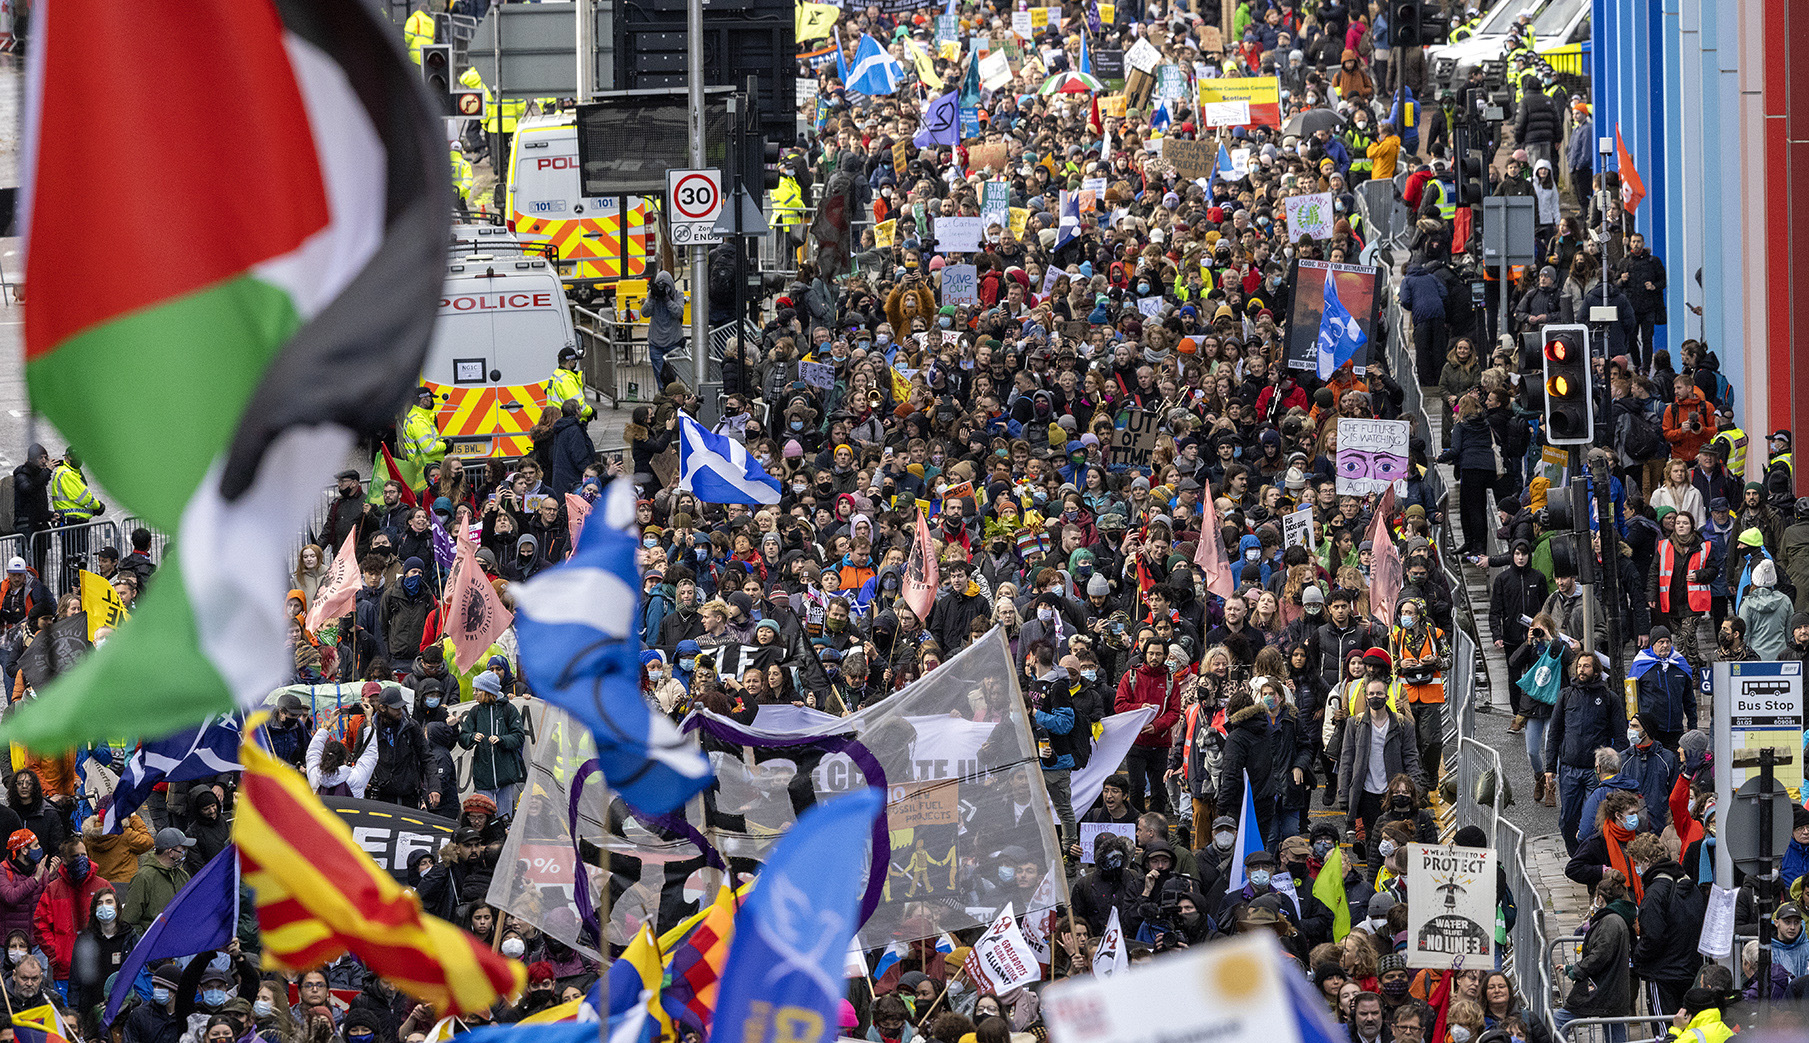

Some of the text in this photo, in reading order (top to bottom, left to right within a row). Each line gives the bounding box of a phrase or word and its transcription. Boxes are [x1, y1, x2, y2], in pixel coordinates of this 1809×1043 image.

[538, 157, 580, 170] POL
[1170, 160, 1209, 171] TRIDENT
[987, 183, 1007, 192] STOP
[680, 187, 711, 205] 30
[988, 191, 1006, 199] WAR
[535, 202, 551, 212] 101
[597, 198, 613, 209] 101
[986, 200, 1007, 208] STOP
[1289, 196, 1327, 213] NO PLANET
[675, 227, 690, 239] 20
[1344, 264, 1375, 273] HUMANITY
[943, 267, 973, 285] Save
[949, 284, 972, 293] our
[944, 294, 973, 305] Planet
[1343, 423, 1397, 435] THE FUTURE
[1122, 431, 1142, 447] OF
[1349, 433, 1401, 445] IS WATCHING
[464, 444, 481, 454] BWL
[1110, 446, 1153, 466] TIME
[1345, 480, 1403, 494] ACT NO!
[336, 556, 345, 585] JUSTICE
[330, 588, 337, 597] IS
[1738, 700, 1794, 712] Bus Stop
[1749, 732, 1755, 740] 2
[888, 801, 943, 816] FOSSIL FUEL
[905, 811, 951, 823] PROJECTS
[1118, 825, 1128, 833] IS
[1423, 856, 1486, 873] PROTECT
[1435, 918, 1469, 930] WATER
[1023, 936, 1045, 954] ANCE
[1426, 934, 1481, 954] NO LINE 3
[993, 944, 1019, 982] GLOBAL JUSTICE
[1001, 939, 1028, 976] GRASSROOTS
